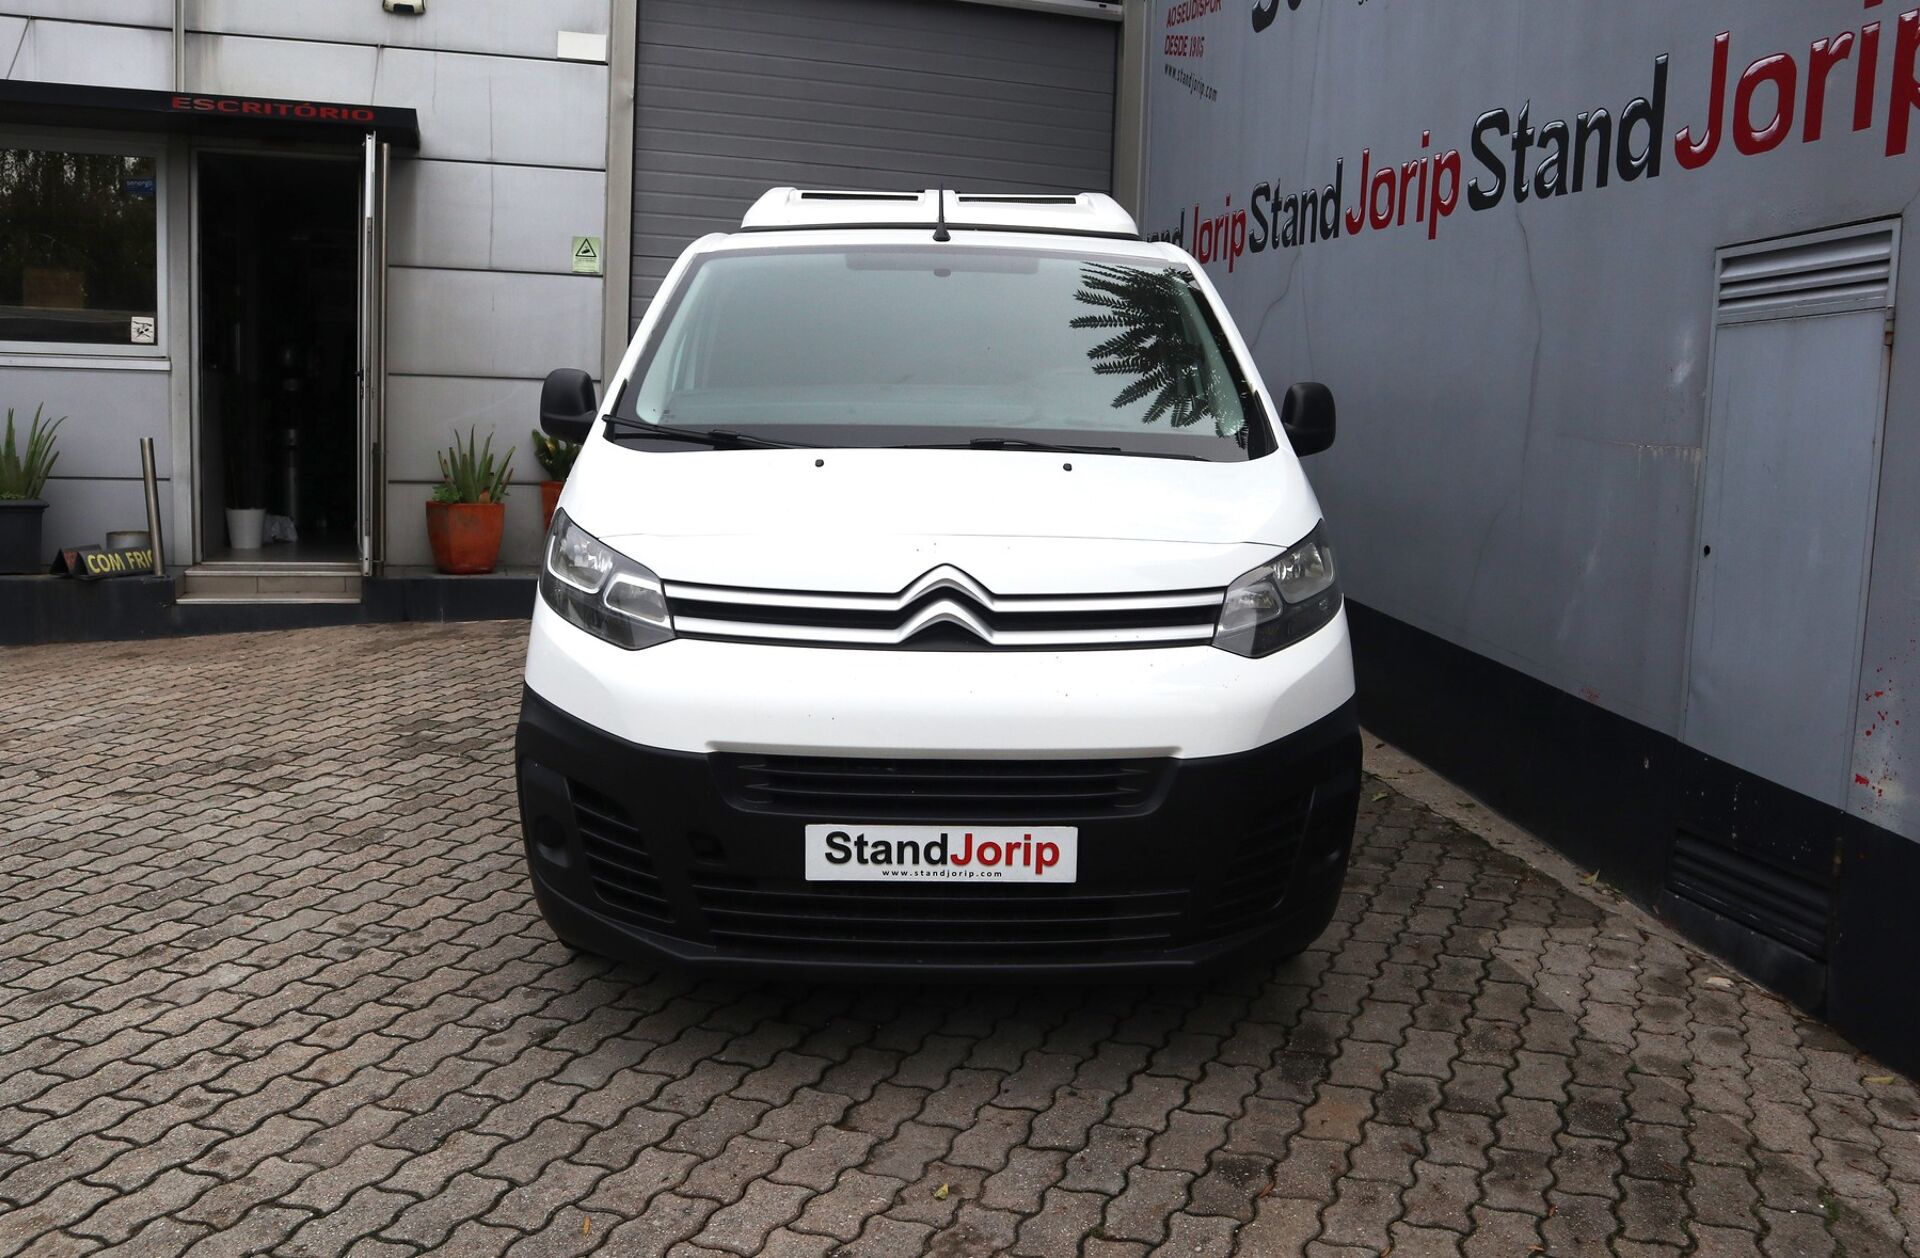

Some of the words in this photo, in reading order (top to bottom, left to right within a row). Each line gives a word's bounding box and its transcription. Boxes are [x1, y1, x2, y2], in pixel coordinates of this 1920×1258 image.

[1164, 35, 1188, 57] DESDE
[171, 97, 374, 121] ESCRITÓRIO
[87, 553, 126, 574] COM
[882, 868, 1003, 878] www.standjorip.com
